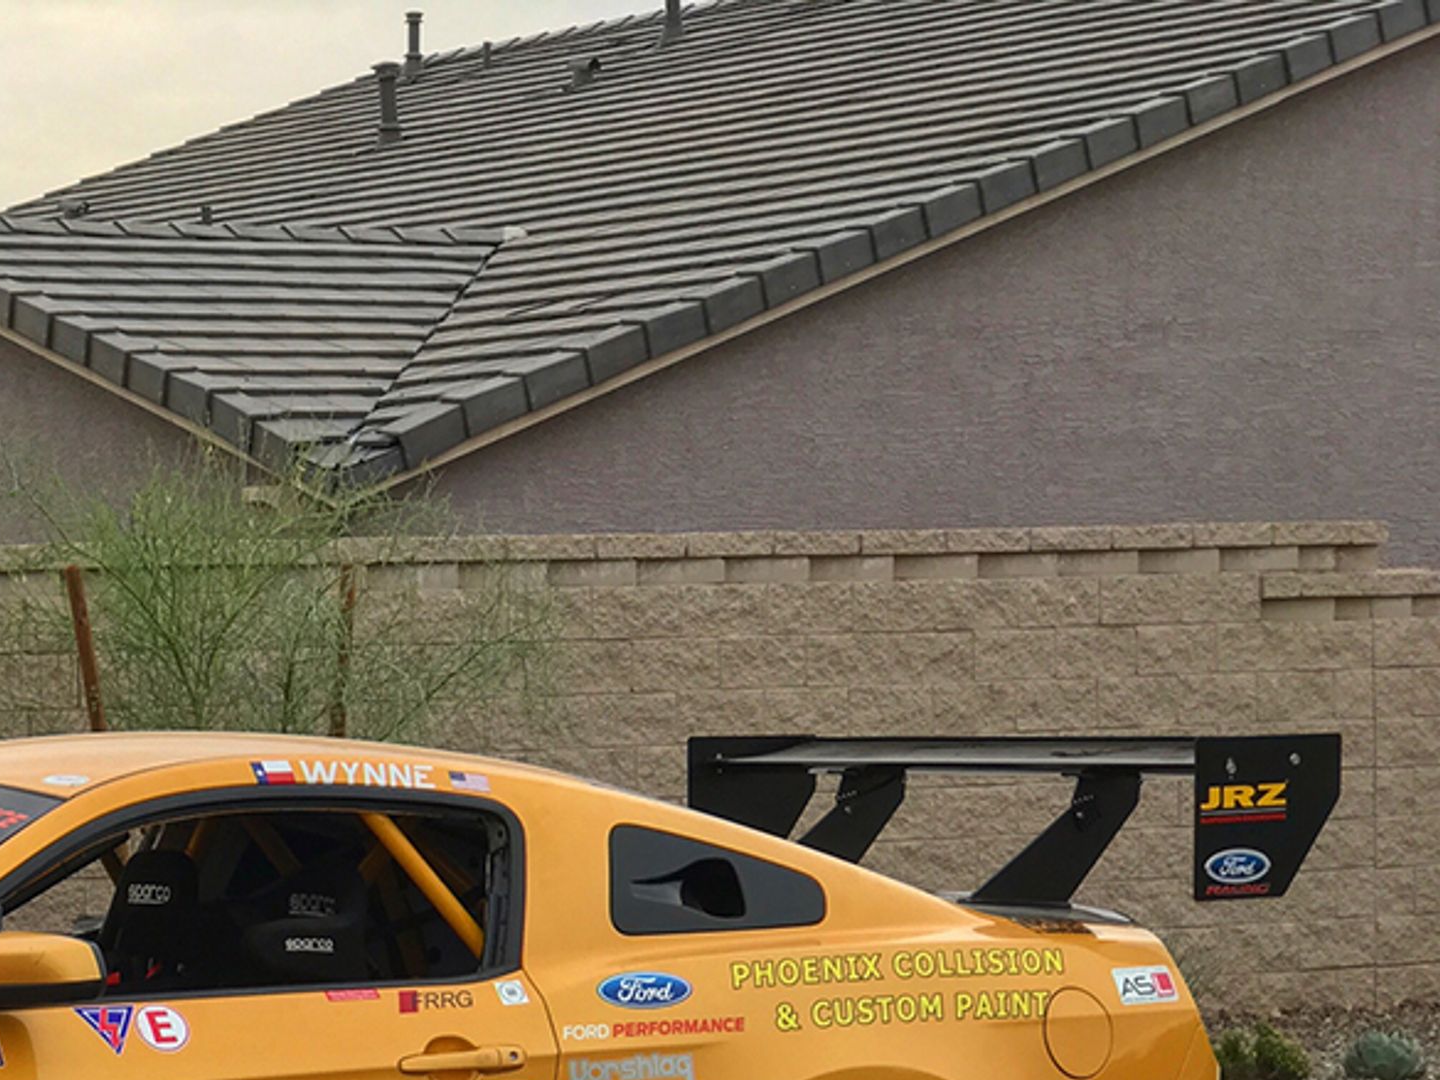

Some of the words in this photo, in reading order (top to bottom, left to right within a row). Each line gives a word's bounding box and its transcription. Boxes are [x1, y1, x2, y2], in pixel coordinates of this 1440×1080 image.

[299, 760, 436, 789] WYNNE
[1200, 782, 1287, 811] JRZ
[1218, 855, 1257, 877] Ford
[127, 884, 171, 904] sparco
[285, 938, 334, 953] sparco
[731, 953, 882, 989] PHOENIX
[891, 948, 1064, 977] COLLISION
[617, 977, 674, 1002] Ford
[776, 1002, 800, 1031] &
[810, 996, 943, 1027] CUSTOM
[956, 990, 1050, 1020] PAINT
[146, 1010, 178, 1043] E
[563, 1023, 609, 1041] FORD
[613, 1017, 745, 1037] PERFORMANCE
